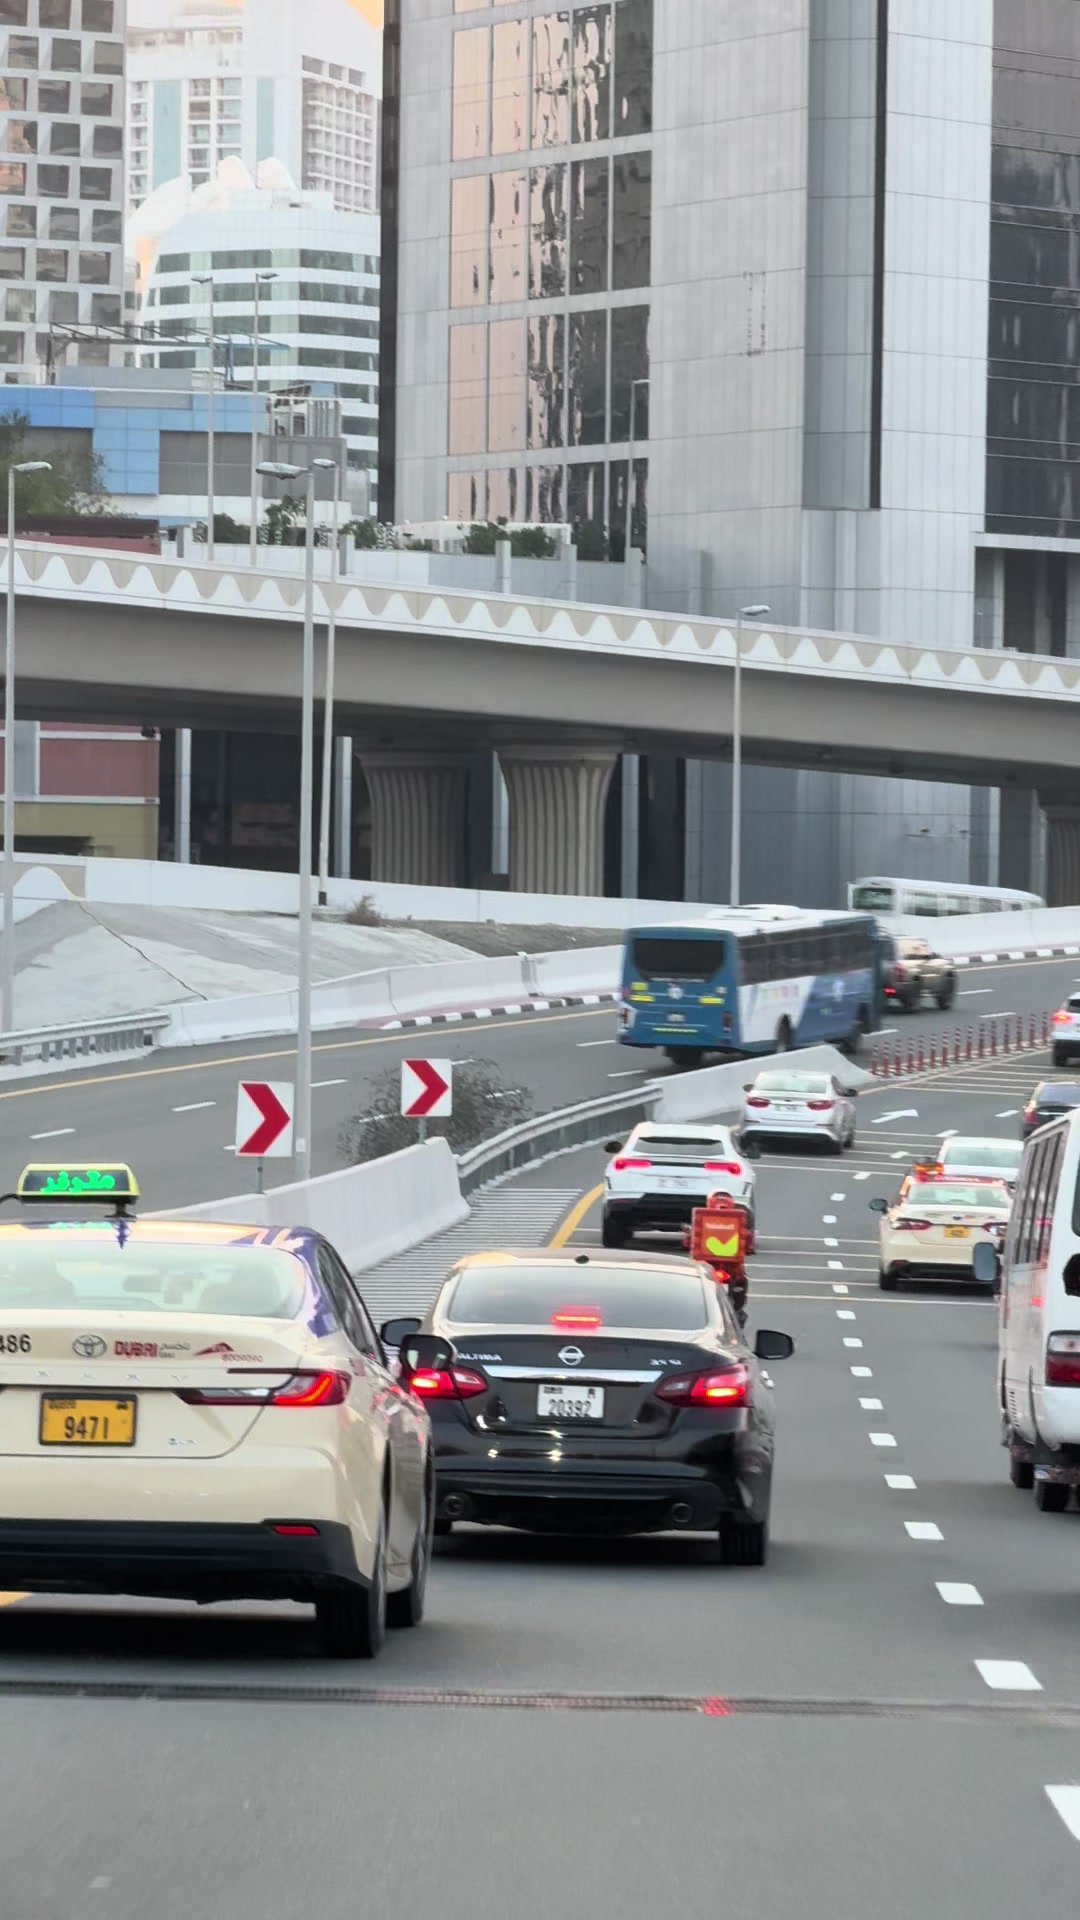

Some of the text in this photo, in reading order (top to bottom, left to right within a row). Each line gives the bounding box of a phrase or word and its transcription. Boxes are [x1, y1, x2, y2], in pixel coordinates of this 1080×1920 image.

[114, 1340, 158, 1358] DUBAI
[548, 1399, 592, 1417] 20392
[64, 1416, 109, 1440] 9471
